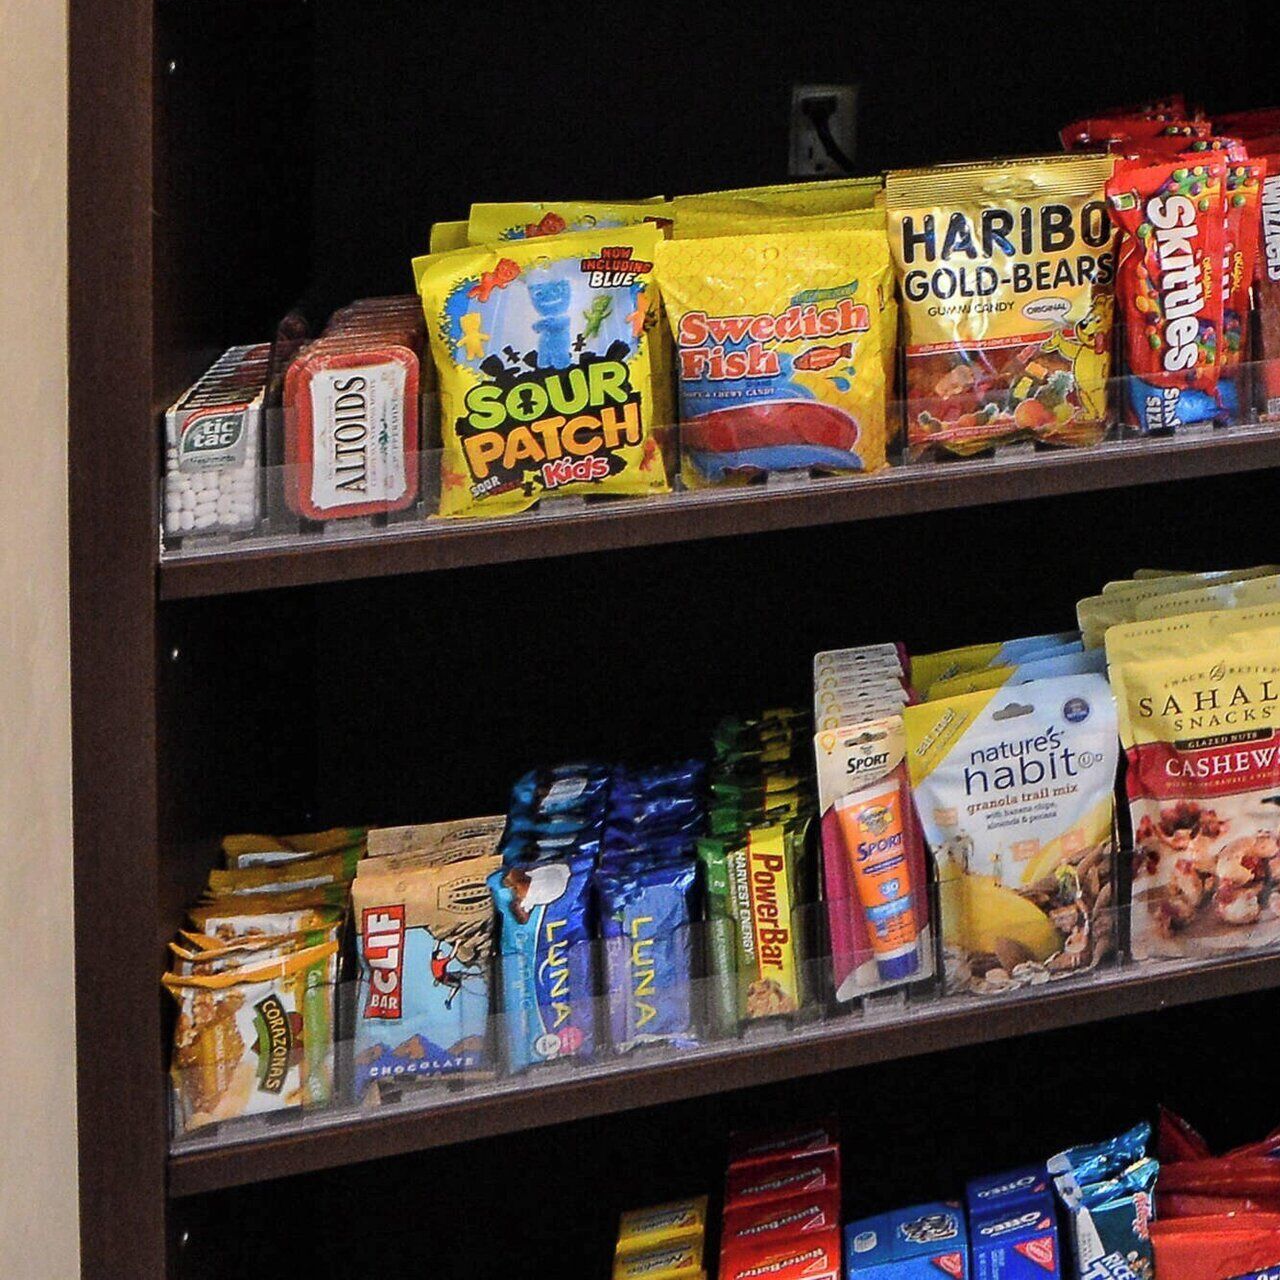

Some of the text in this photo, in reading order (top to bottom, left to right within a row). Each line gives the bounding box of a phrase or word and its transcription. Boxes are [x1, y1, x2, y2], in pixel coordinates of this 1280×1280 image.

[902, 200, 1112, 264] HARIBO
[590, 271, 636, 287] BLUE
[903, 251, 1115, 303] GOLD-BEARS
[1147, 195, 1205, 372] Skittles
[679, 299, 870, 347] Swedish
[680, 340, 779, 381] Fish
[467, 362, 630, 430] SOUR
[335, 374, 368, 496] ALTOIDS
[464, 402, 641, 478] PATCH
[542, 455, 609, 488] Kids
[1174, 707, 1273, 733] SNACKS
[846, 752, 888, 775] SPORT
[964, 748, 1077, 797] habit
[966, 796, 1018, 817] granola
[856, 833, 902, 863] SPORT
[735, 849, 755, 967] HARVEST ENERGY
[761, 852, 789, 971] PowerBar
[368, 912, 401, 995] CLIF
[545, 919, 572, 1029] LUNA
[630, 916, 657, 1027] LUNA
[371, 995, 398, 1010] BAR
[261, 998, 287, 1091] CORAZONAS
[369, 1057, 474, 1077] CHOCOLATE
